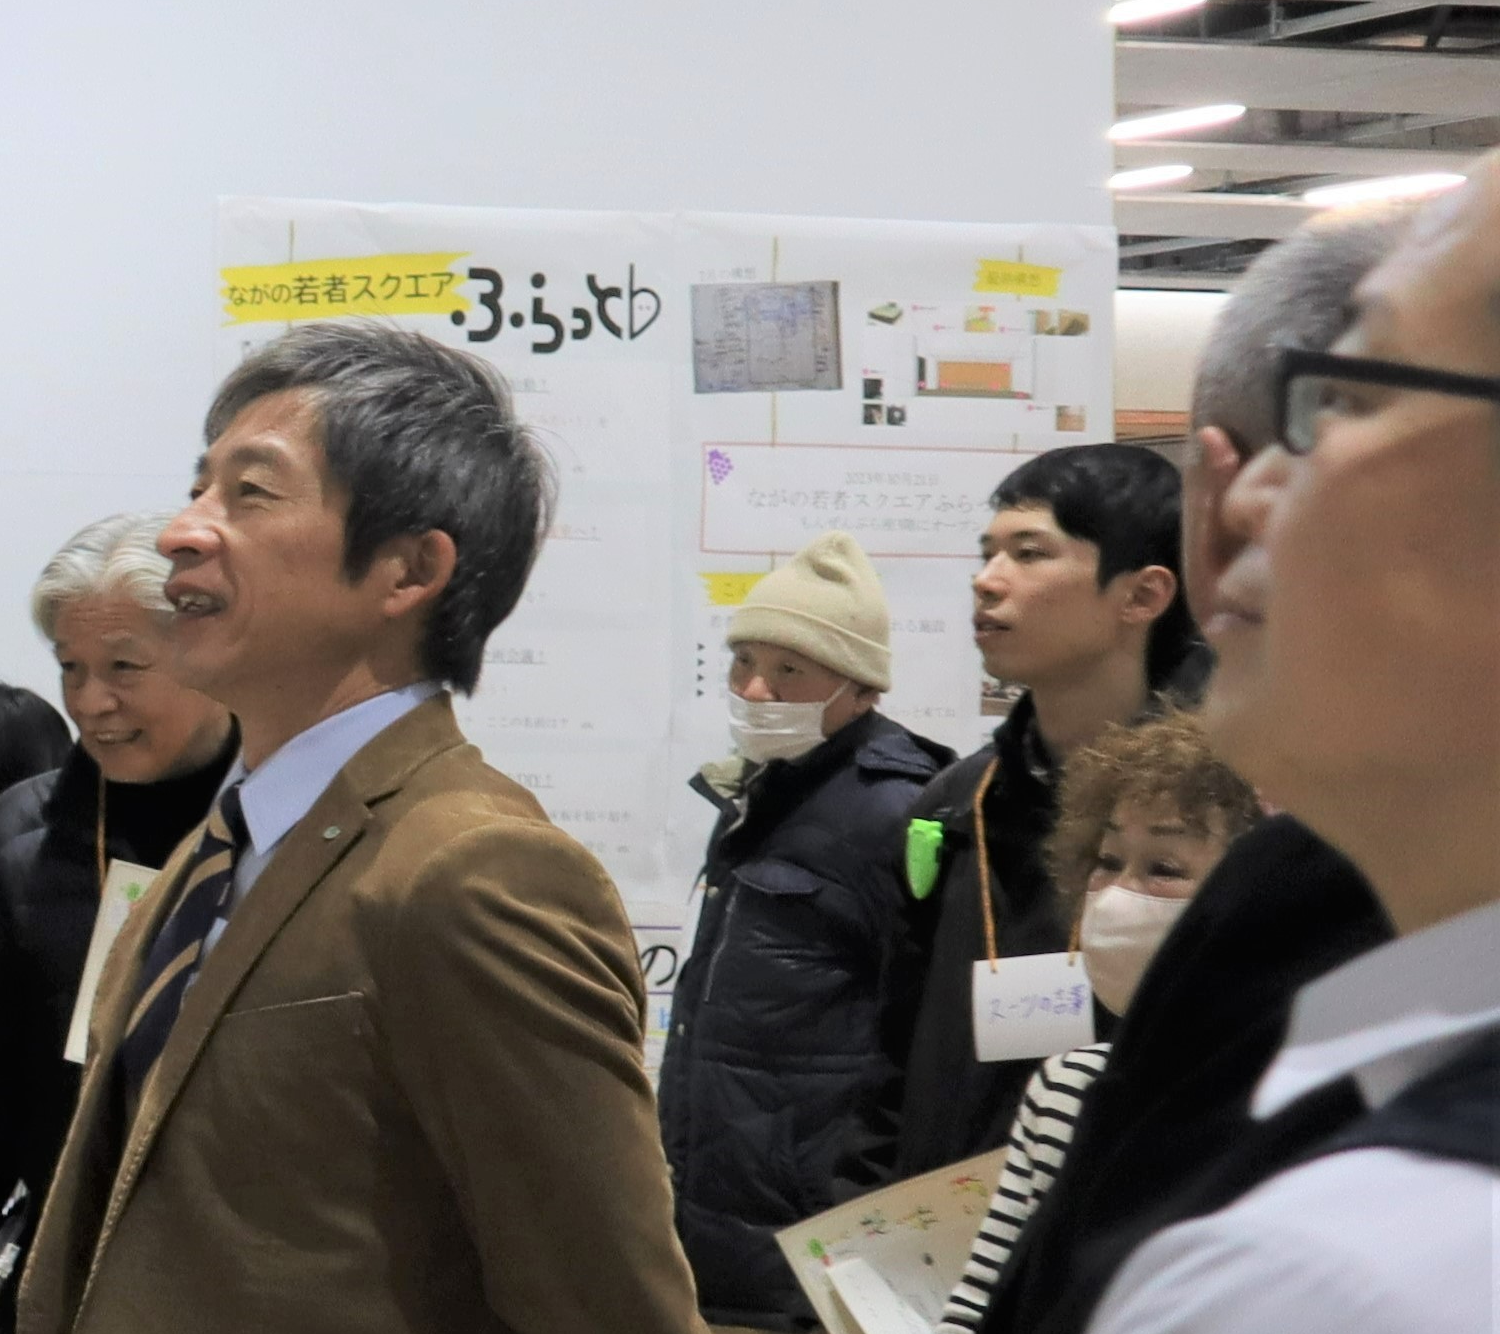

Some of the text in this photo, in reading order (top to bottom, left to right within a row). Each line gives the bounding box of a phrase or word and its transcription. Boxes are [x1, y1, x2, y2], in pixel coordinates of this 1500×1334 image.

[228, 270, 455, 306] ながの若者スクエア
